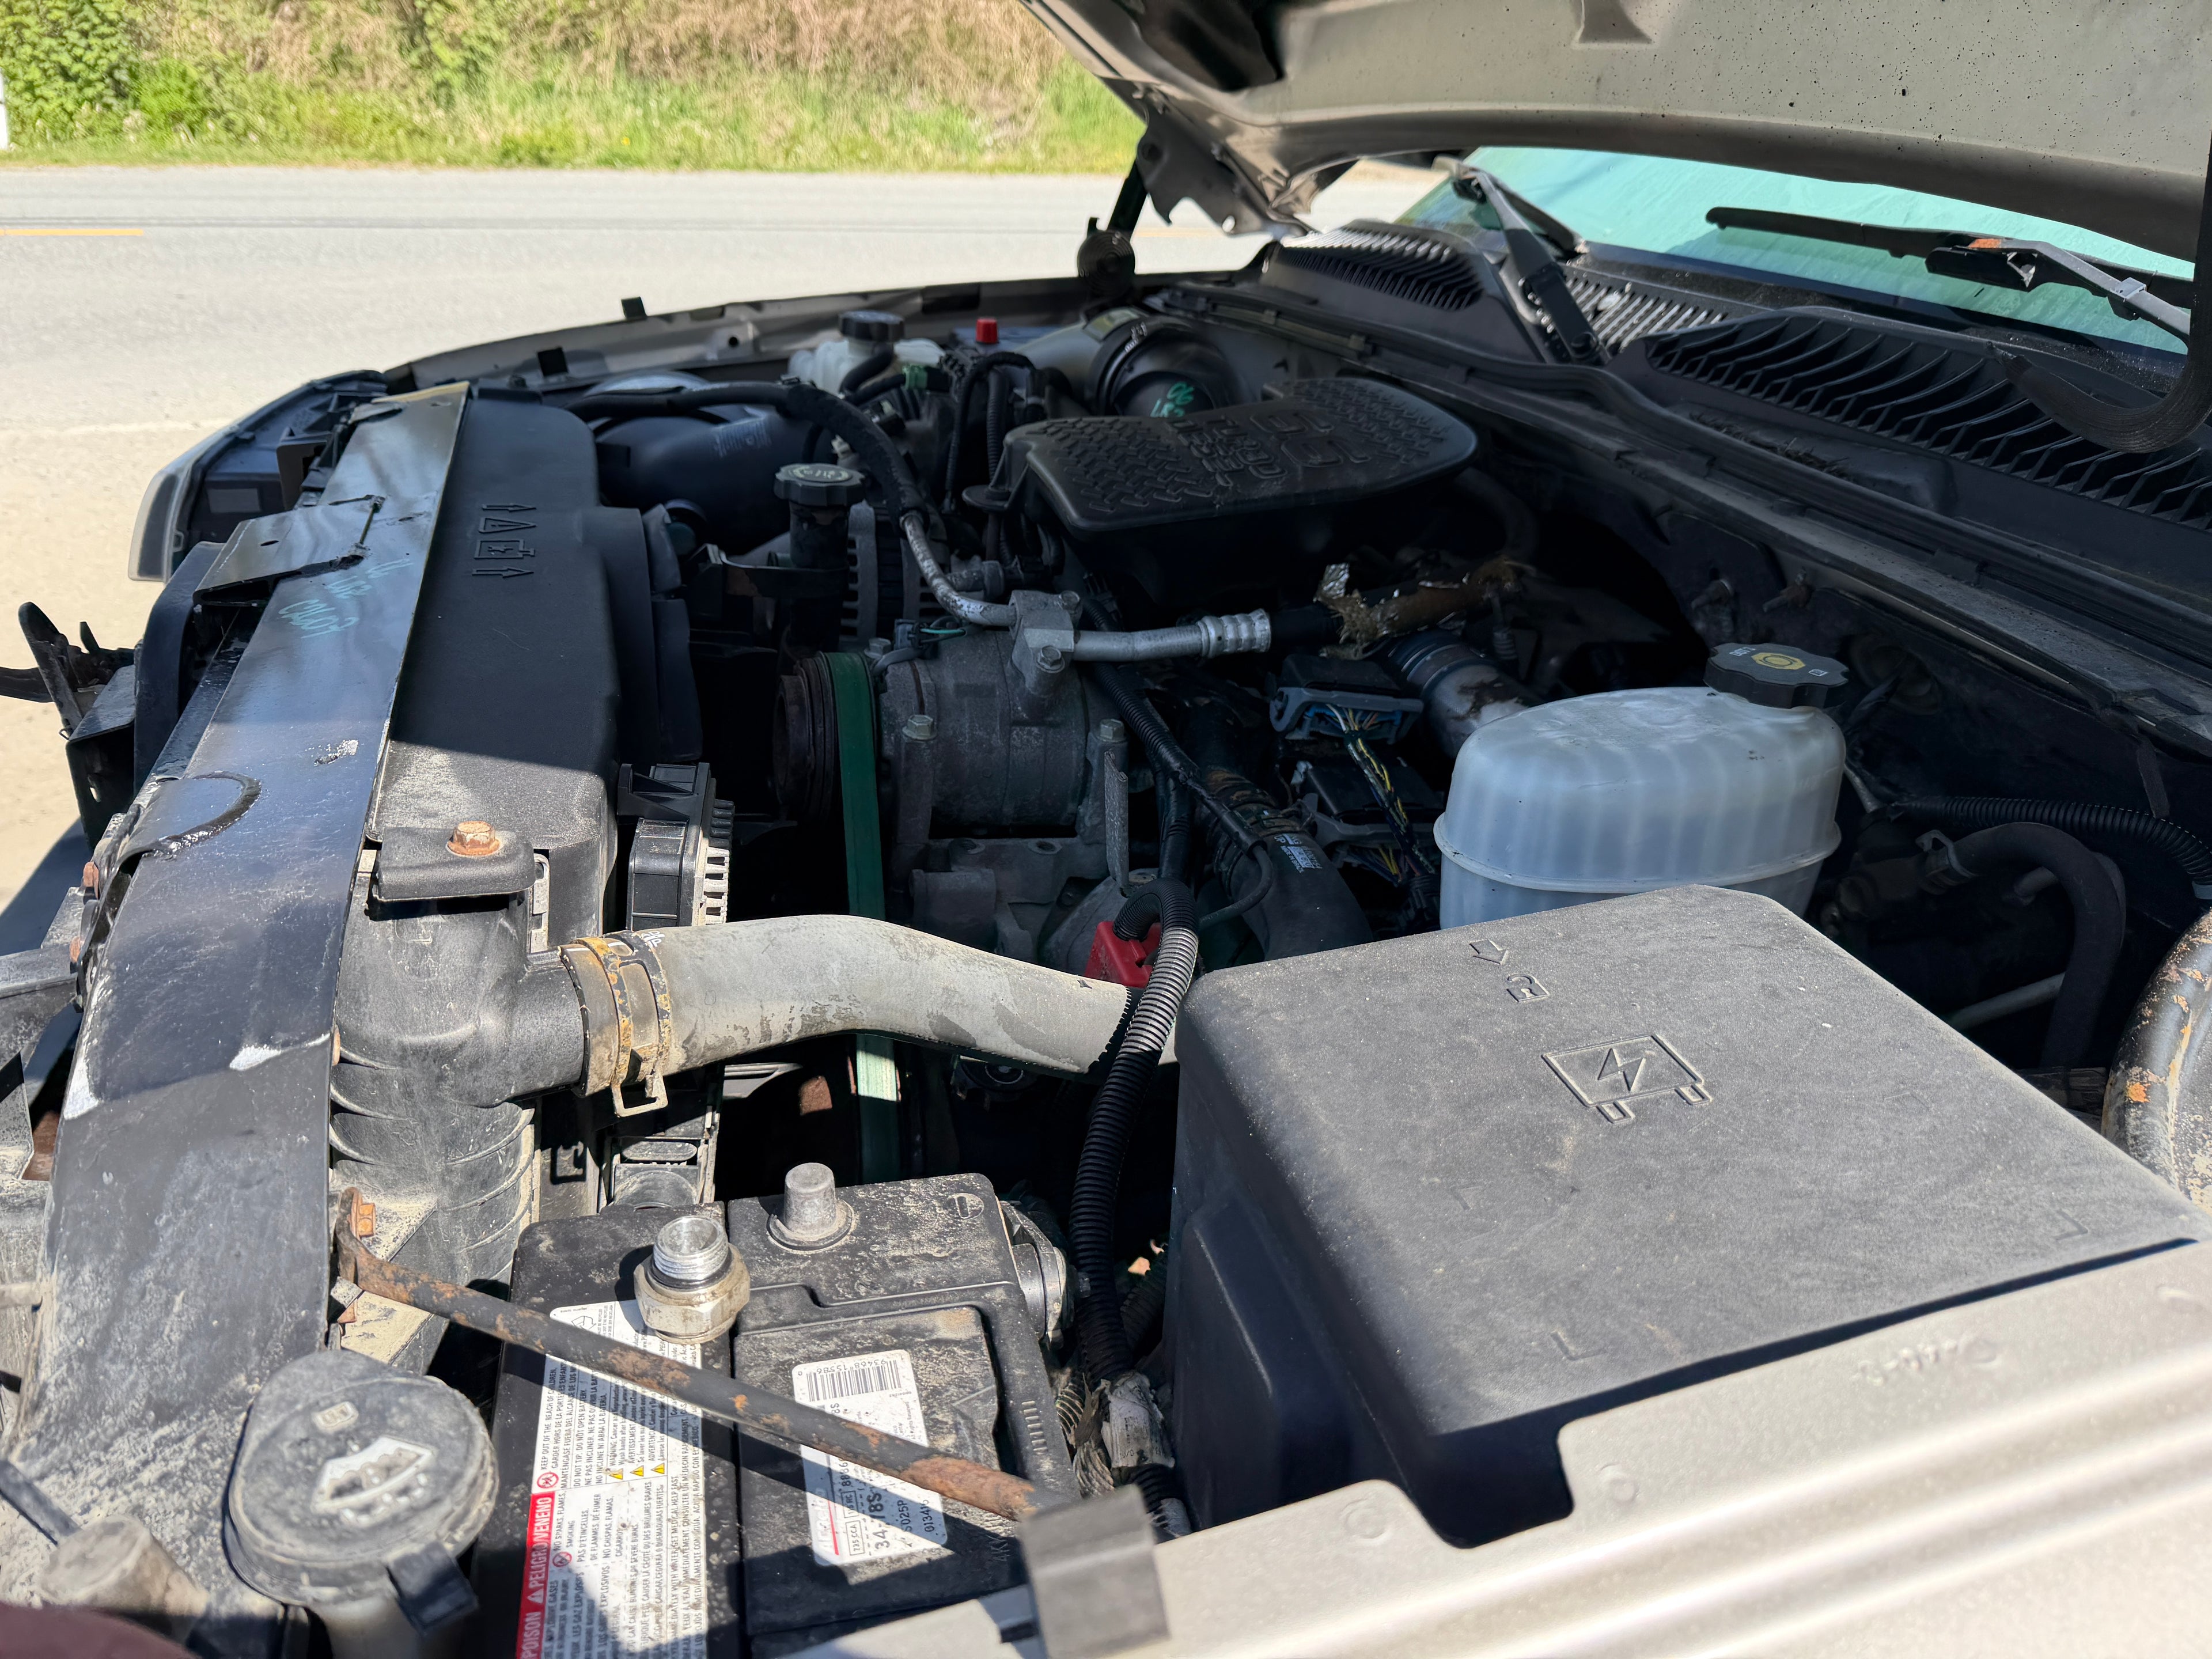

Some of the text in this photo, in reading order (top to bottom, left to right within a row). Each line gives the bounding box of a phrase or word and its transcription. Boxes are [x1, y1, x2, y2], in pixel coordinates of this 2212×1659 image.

[816, 1364, 849, 1374] 15586
[854, 1358, 887, 1369] 93468
[544, 1403, 554, 1420] REACH
[577, 1413, 585, 1427] OPEN
[543, 1423, 551, 1433] THE
[597, 1426, 605, 1441] ABRA
[553, 1429, 561, 1444] HORS
[563, 1428, 571, 1445] FUERA
[576, 1429, 584, 1440] NOT
[541, 1444, 550, 1453] OUT
[575, 1442, 583, 1450] DO
[540, 1456, 548, 1469] KEEP
[551, 1445, 560, 1468] GARDER
[596, 1450, 604, 1473] INCLINE
[692, 1456, 700, 1468] CON
[574, 1465, 582, 1476] NOT
[585, 1464, 593, 1475] PAS
[573, 1478, 581, 1486] DO
[595, 1475, 603, 1483] NO
[593, 1493, 601, 1512] FUMER
[845, 1494, 853, 1503] RC
[566, 1520, 575, 1547] SMOKING
[643, 1530, 651, 1539] DES
[849, 1523, 858, 1537] CCA
[552, 1541, 561, 1551] NO
[577, 1549, 586, 1562] PAS
[602, 1548, 611, 1558] NO
[641, 1577, 650, 1601] CAUSER
[520, 1611, 542, 1659] POISON
